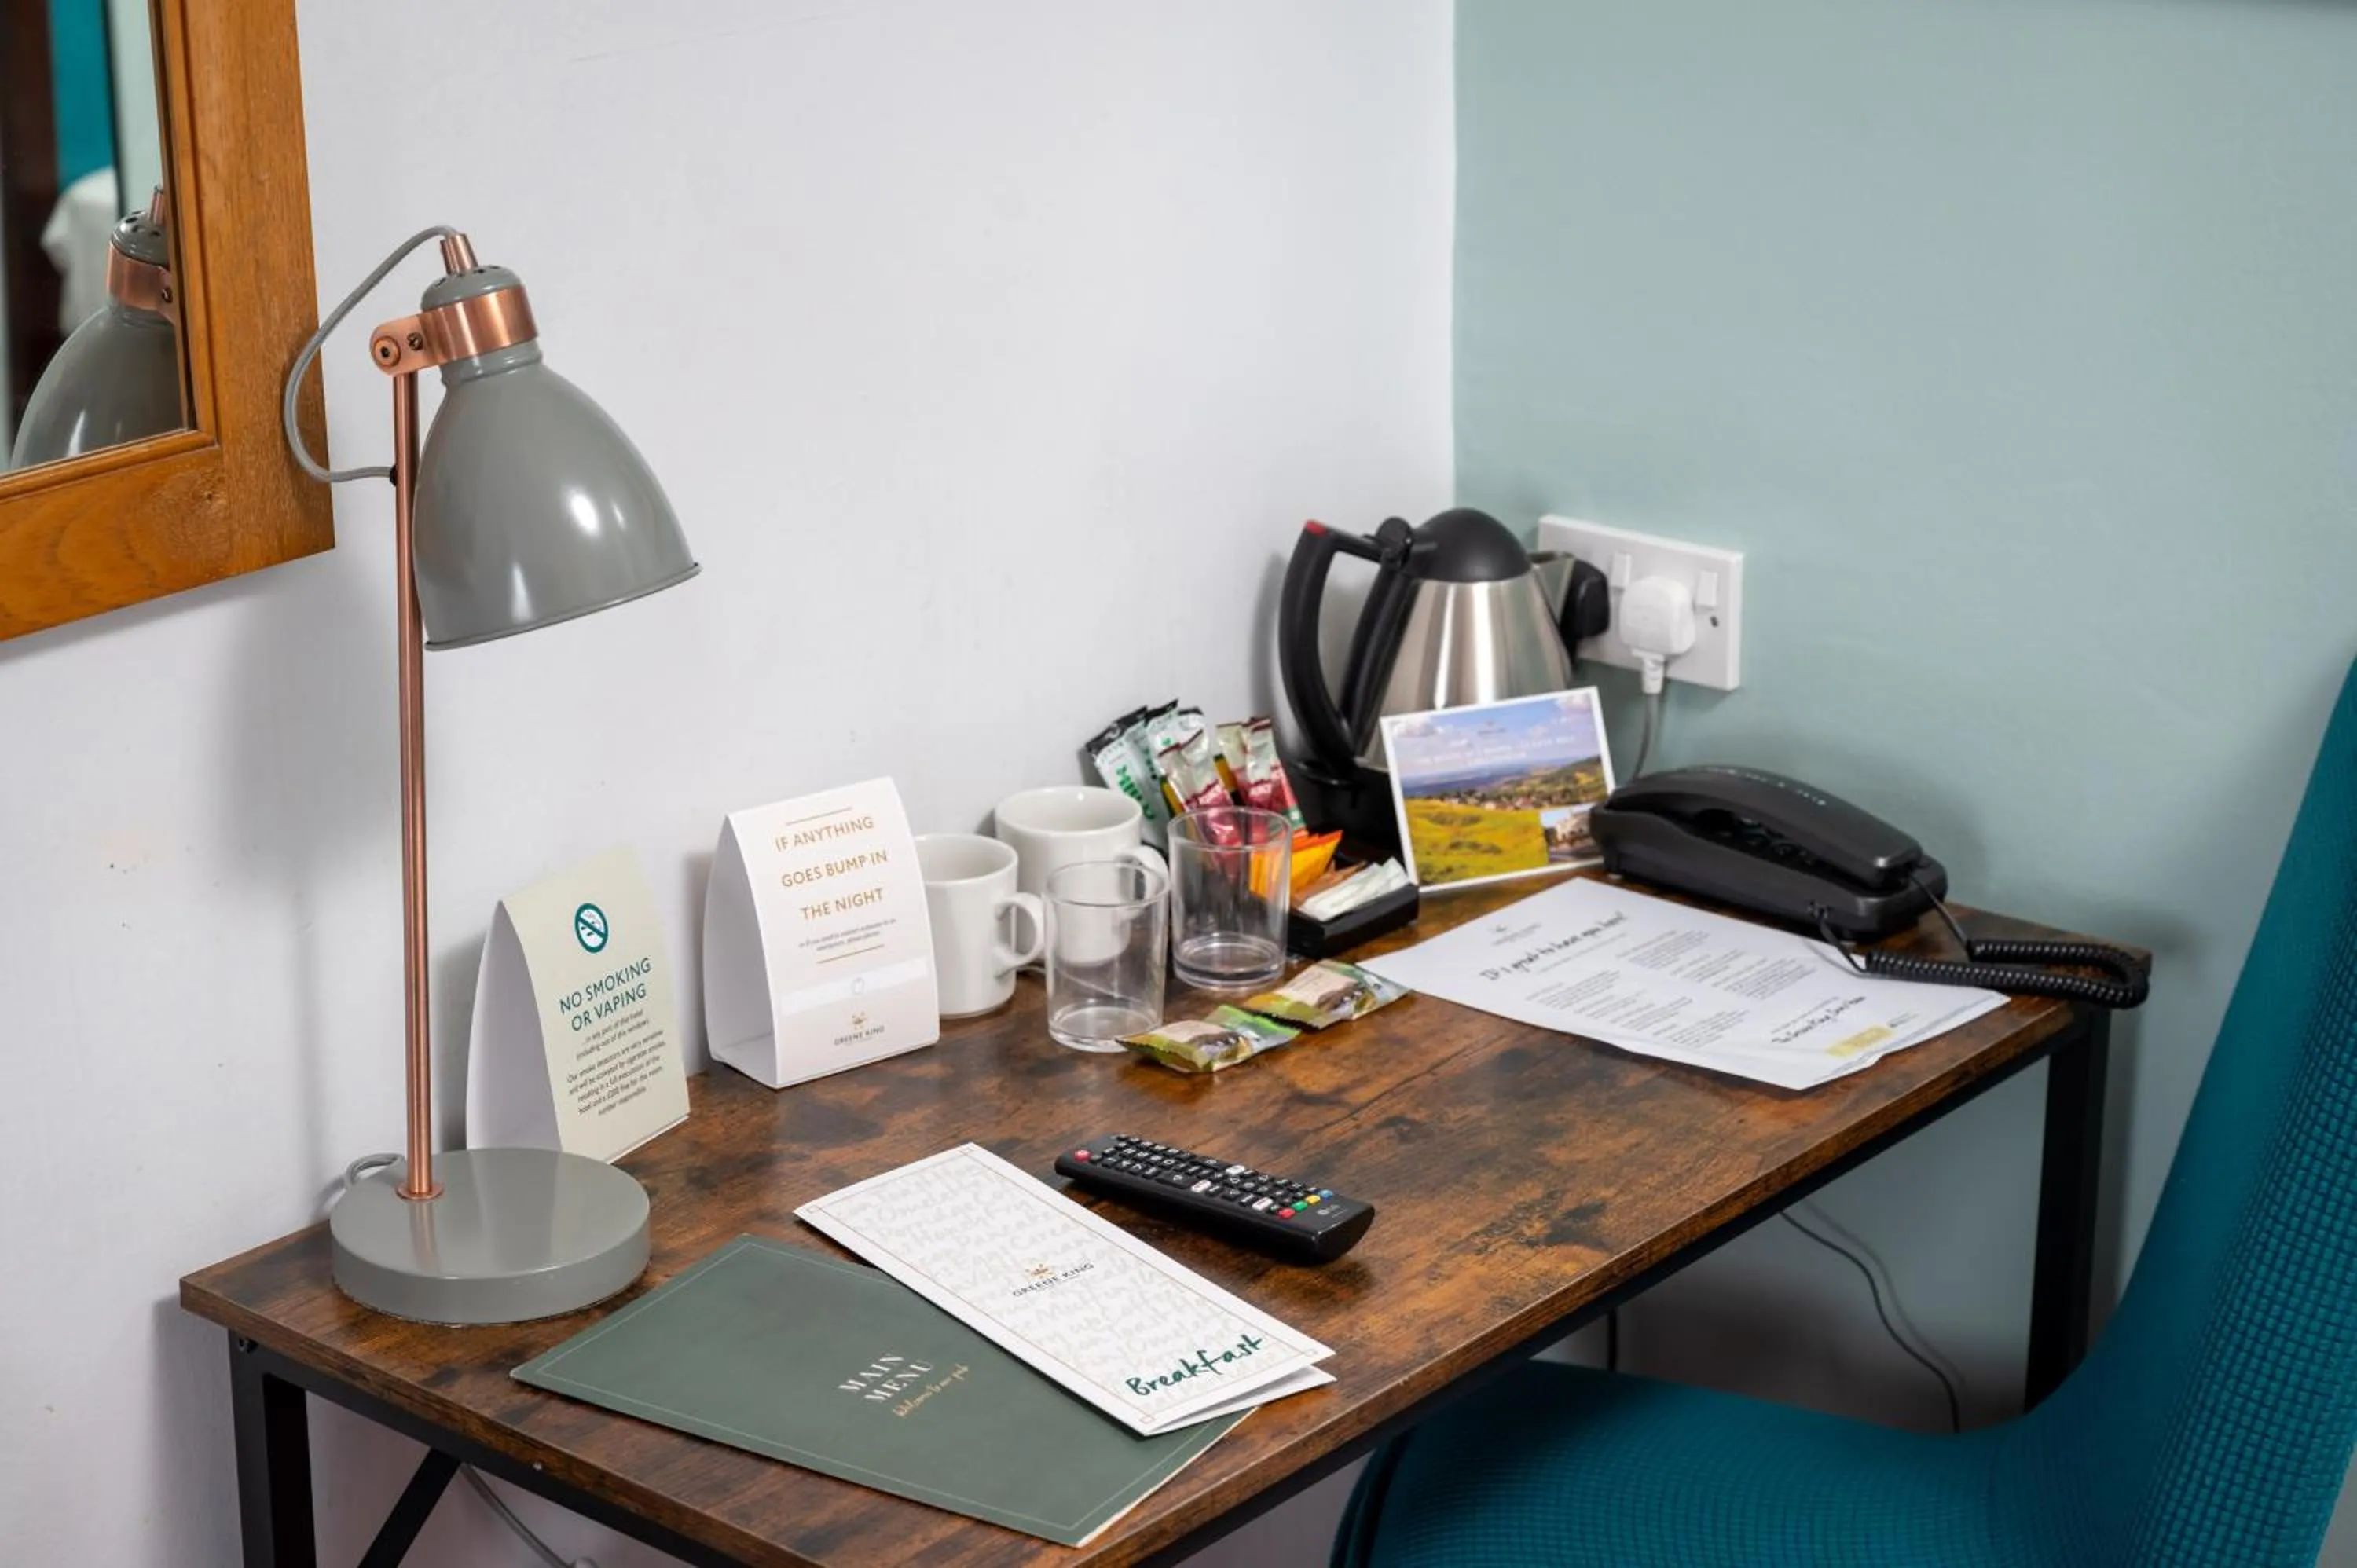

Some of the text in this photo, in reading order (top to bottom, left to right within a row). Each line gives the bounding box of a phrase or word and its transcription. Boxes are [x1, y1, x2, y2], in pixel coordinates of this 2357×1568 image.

[775, 816, 874, 852] IF ANYTHING
[781, 849, 888, 887] GOES BUMP IN
[799, 888, 884, 920] THE NIGHT
[559, 957, 651, 1015] NO SMOKING
[571, 983, 647, 1031] OR VAPING
[1012, 1262, 1094, 1297] GREENE KING
[838, 1354, 904, 1390] MAIN
[863, 1360, 934, 1401] MENU
[1124, 1333, 1263, 1396] Breakfast
